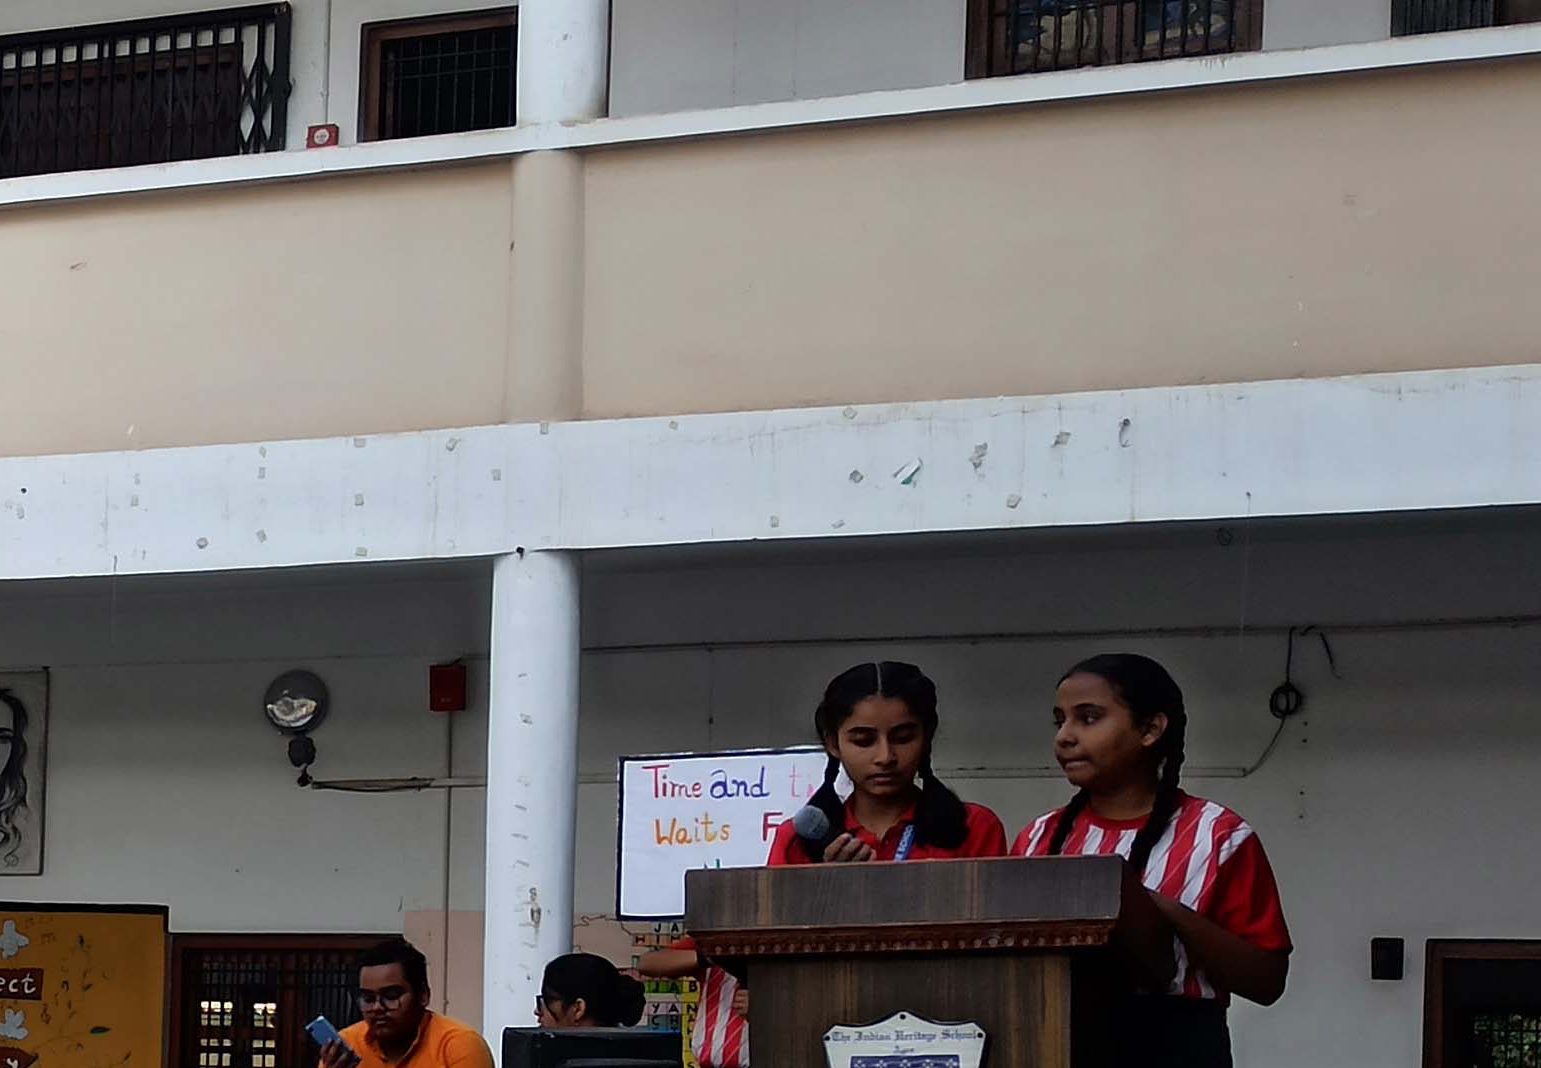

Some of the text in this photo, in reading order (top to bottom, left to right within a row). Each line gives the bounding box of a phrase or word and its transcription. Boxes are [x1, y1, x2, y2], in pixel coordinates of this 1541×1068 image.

[642, 764, 702, 798] Time
[710, 766, 770, 799] and
[655, 811, 731, 846] Waits
[832, 1028, 977, 1043] The Indian Heritage School
